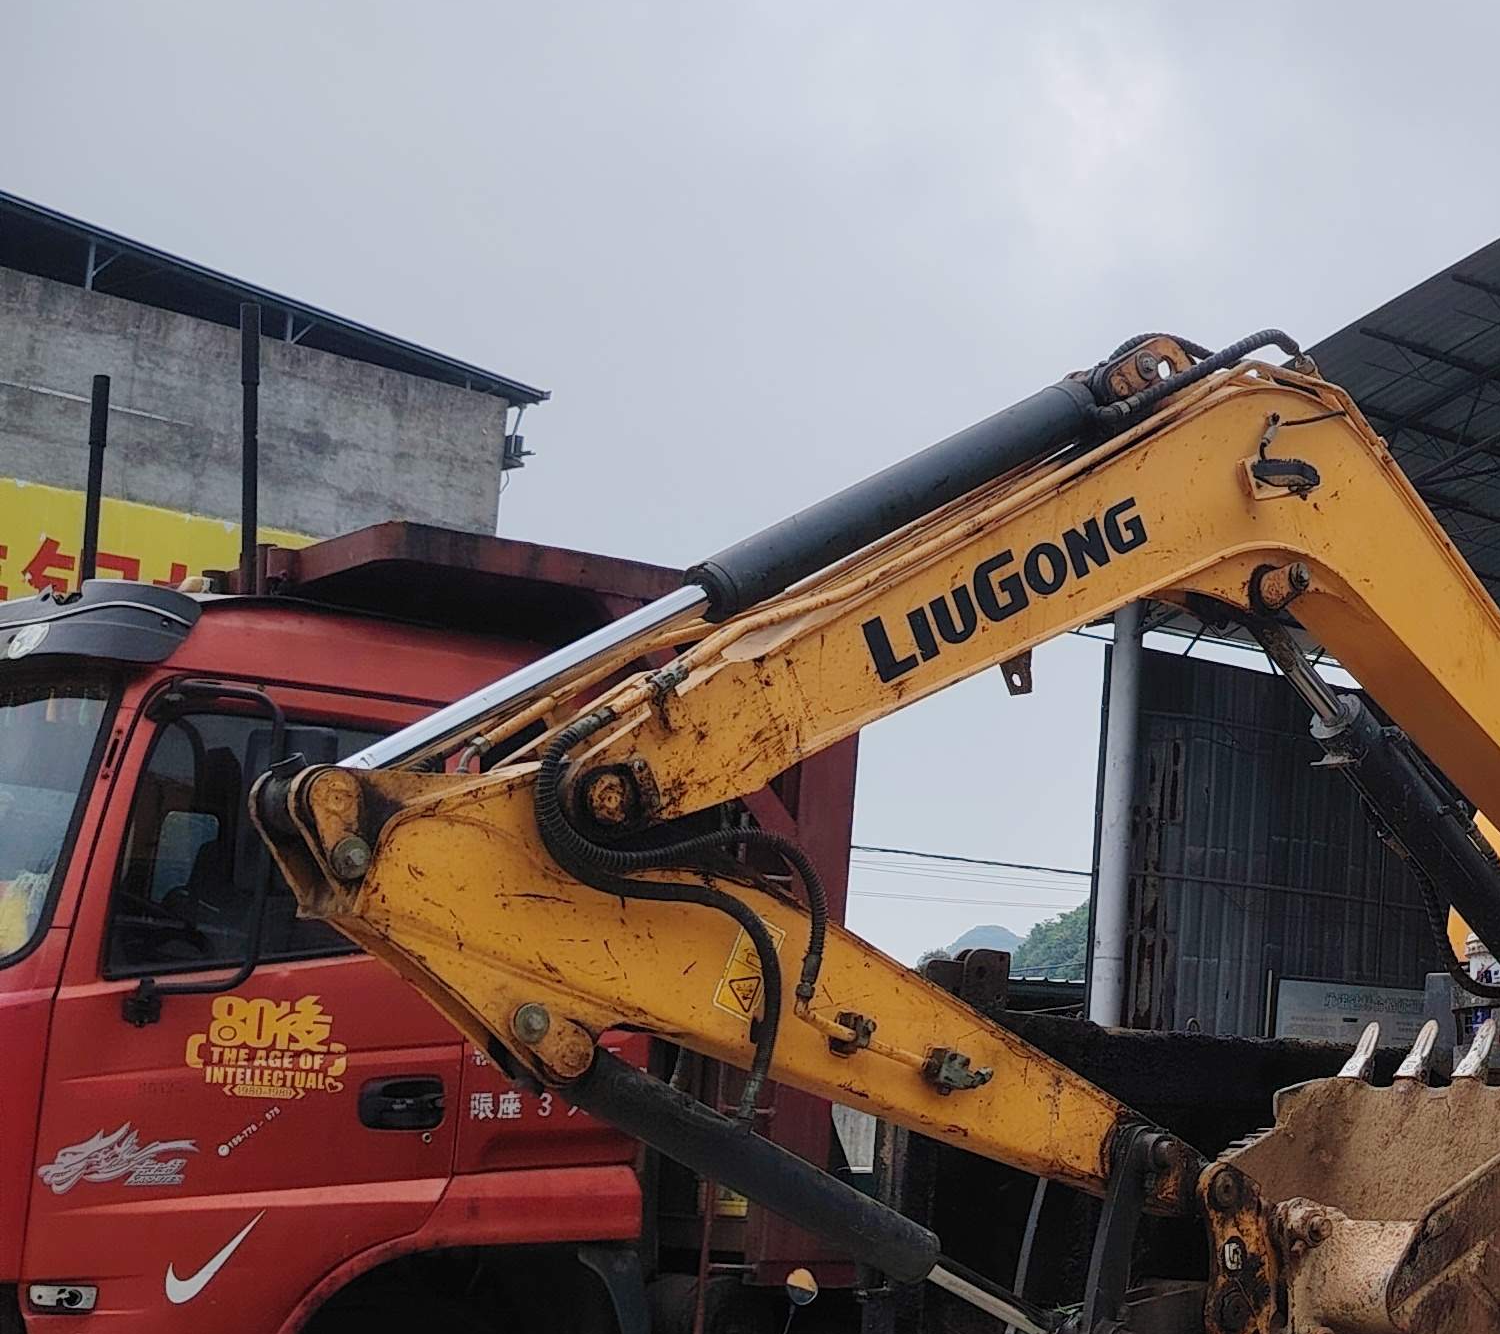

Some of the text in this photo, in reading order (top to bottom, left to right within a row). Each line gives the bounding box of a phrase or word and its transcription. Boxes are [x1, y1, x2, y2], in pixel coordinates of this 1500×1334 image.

[861, 496, 1148, 684] LIUGONG
[210, 1046, 326, 1070] THE AGE OF
[204, 1065, 326, 1090] INTELLECTUAL
[469, 1090, 523, 1120] 限座
